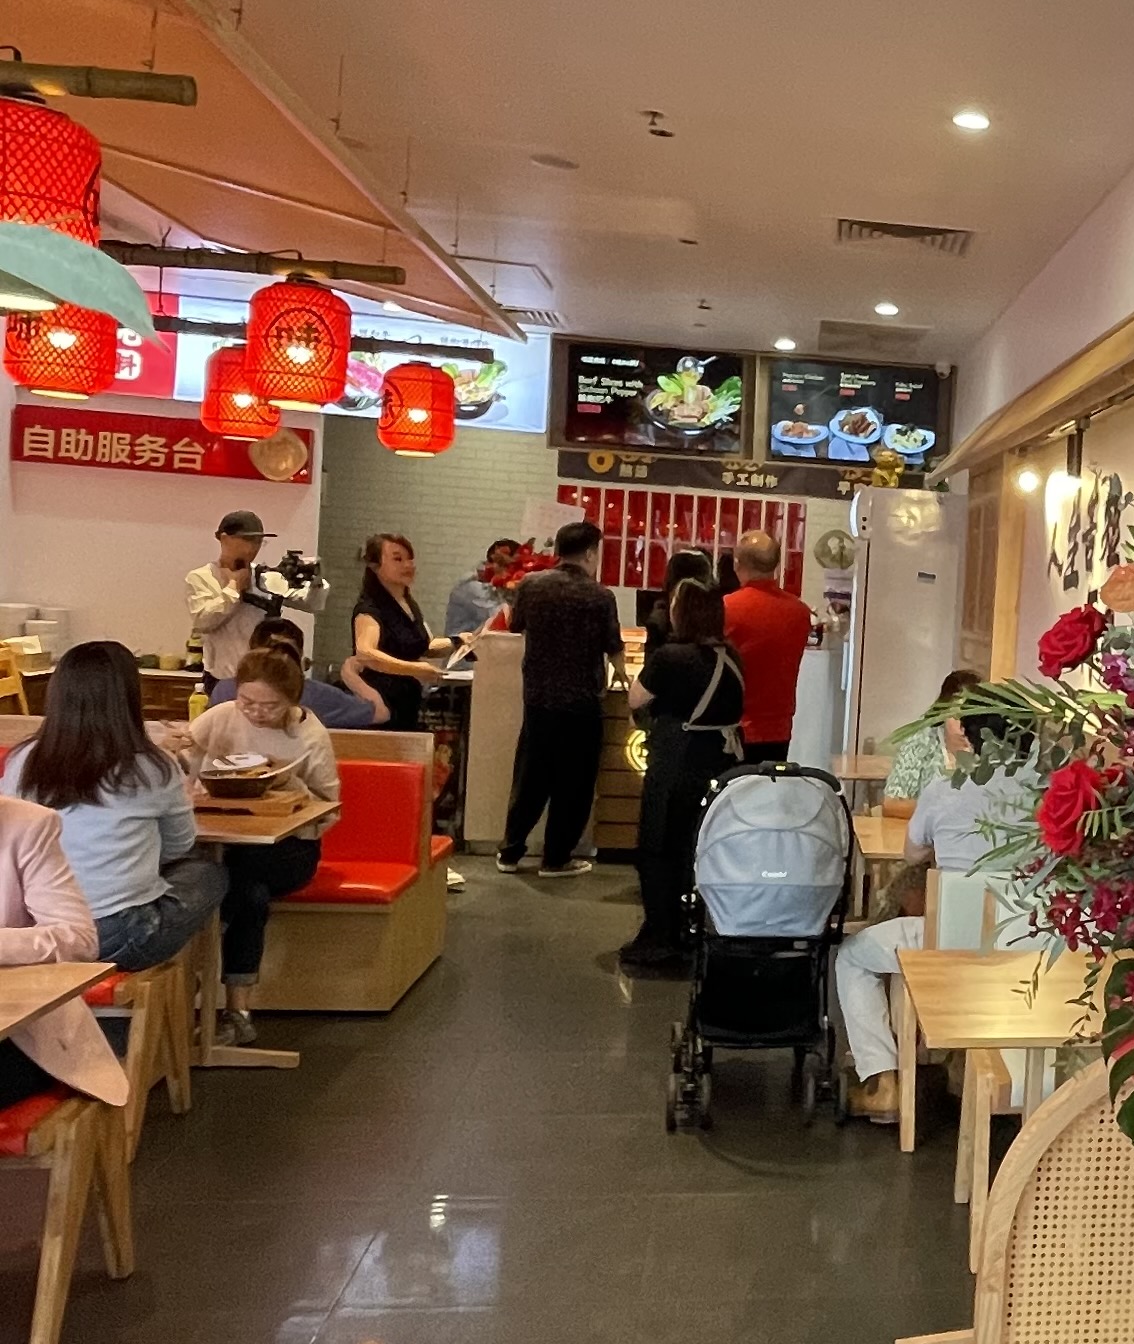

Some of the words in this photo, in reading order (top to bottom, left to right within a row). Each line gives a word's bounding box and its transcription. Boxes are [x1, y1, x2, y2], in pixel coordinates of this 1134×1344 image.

[22, 425, 205, 471] 自助服务台
